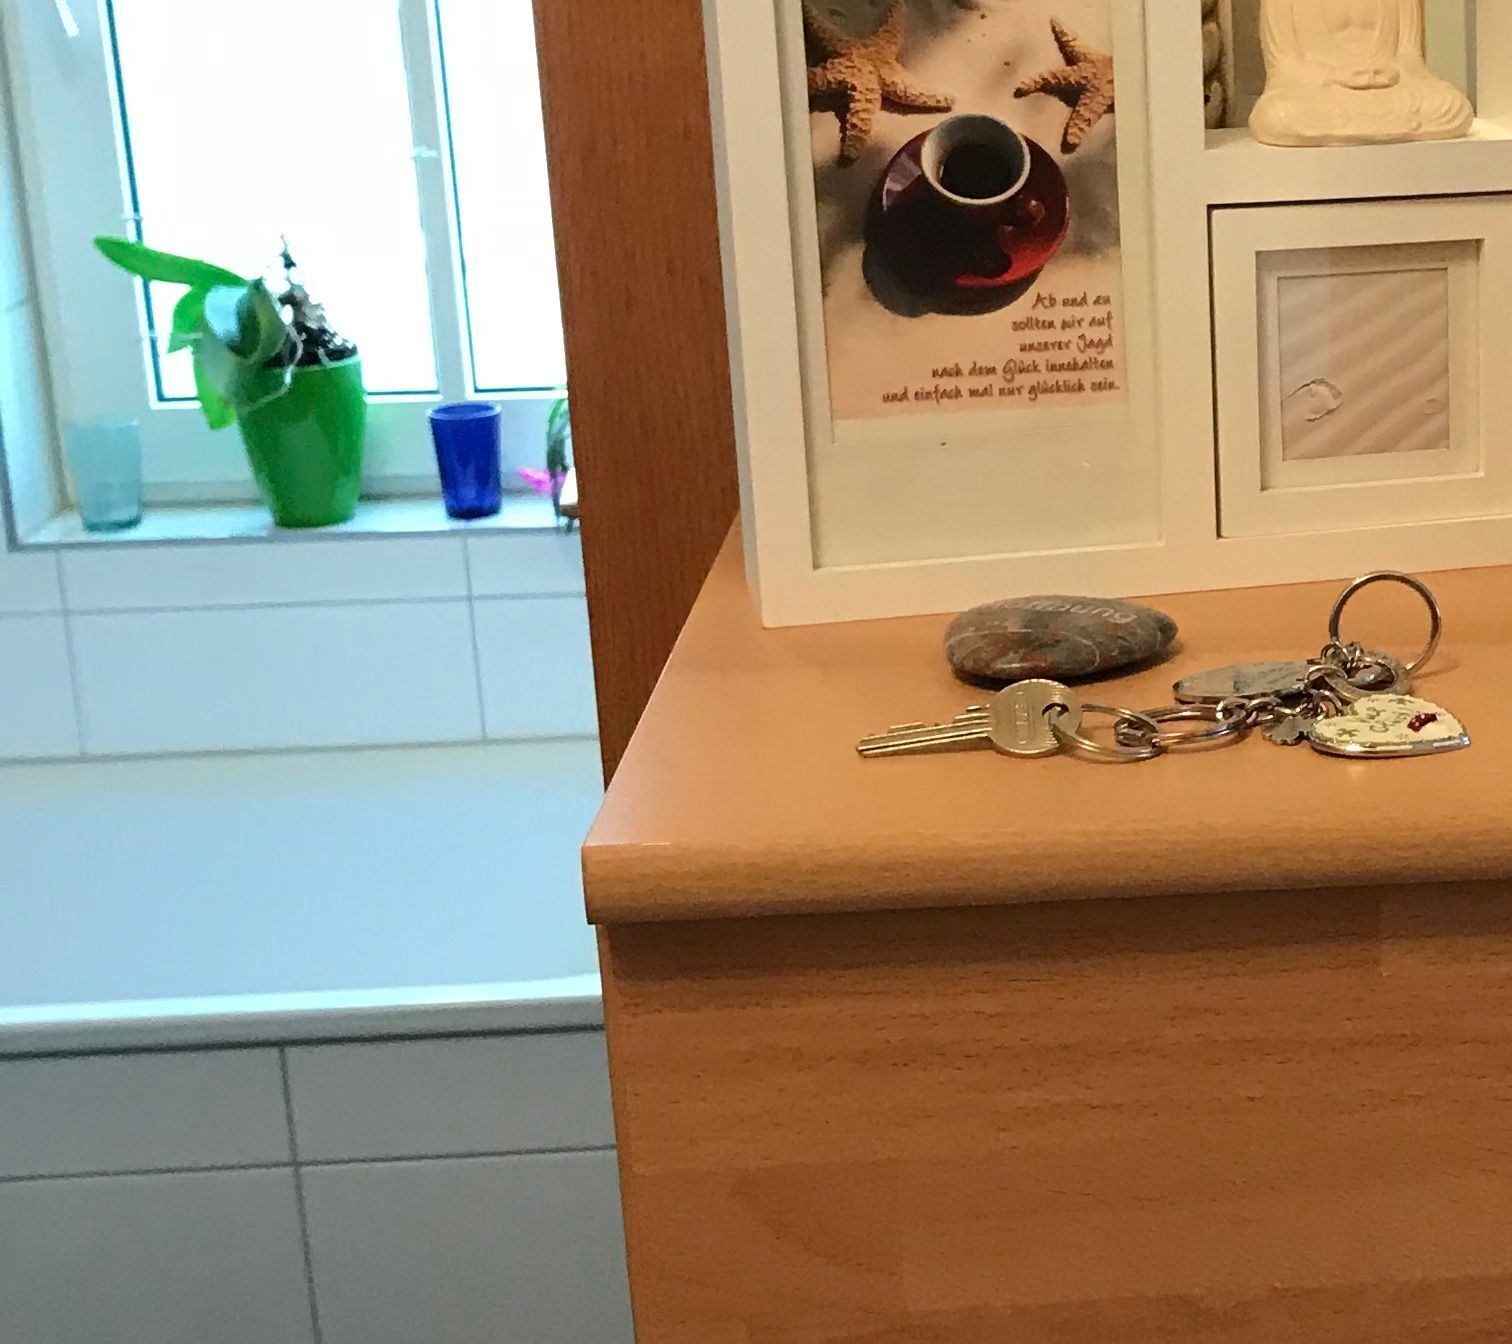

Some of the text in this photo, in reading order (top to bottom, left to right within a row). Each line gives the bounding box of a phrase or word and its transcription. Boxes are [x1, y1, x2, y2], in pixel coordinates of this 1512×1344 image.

[1062, 291, 1088, 307] und
[1093, 294, 1112, 306] zu
[1012, 310, 1113, 332] sollten wir auf
[1020, 332, 1113, 355] unserer Jagd
[932, 362, 964, 378] nach
[968, 360, 998, 376] dem
[1046, 357, 1114, 372] innehalten
[883, 387, 909, 403] und
[914, 384, 964, 405] einfach
[969, 383, 993, 398] mal
[999, 385, 1024, 397] nur
[1028, 378, 1086, 401] glücklich
